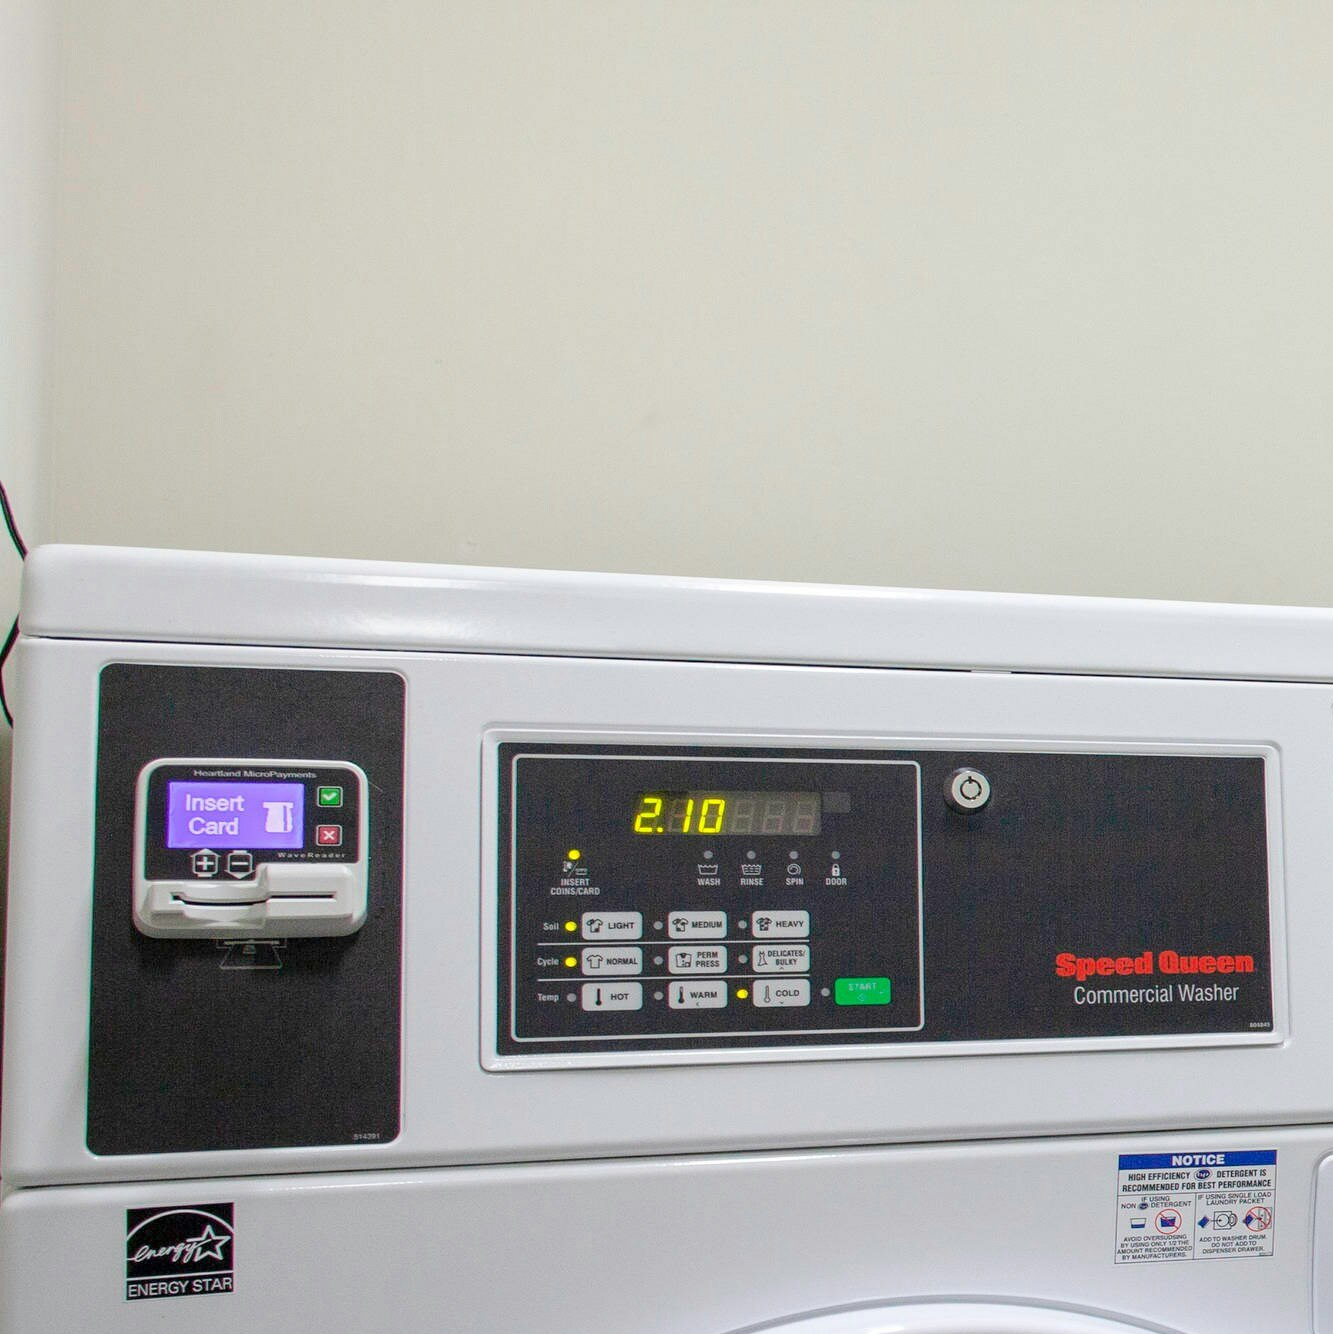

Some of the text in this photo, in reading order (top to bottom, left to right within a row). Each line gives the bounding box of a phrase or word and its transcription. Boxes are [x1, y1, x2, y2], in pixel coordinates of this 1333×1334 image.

[186, 794, 244, 811] Insert
[634, 798, 726, 834] 2.10
[189, 817, 238, 834] Card
[537, 958, 559, 967] Cycle
[1056, 951, 1254, 980] Speed Queen
[538, 994, 559, 1002] Temp
[1074, 984, 1239, 1005] Commercial Washer
[1172, 1155, 1225, 1166] NOTICE
[1128, 1173, 1146, 1181] HIGH
[1148, 1172, 1190, 1180] EFFICIENCY
[1217, 1170, 1258, 1178] DETERGENT
[1123, 1182, 1179, 1192] RECOMMENDED
[1182, 1182, 1196, 1190] FOR
[1218, 1180, 1271, 1188] PERFORMANCE
[128, 1278, 232, 1297] ENERGY STAR
